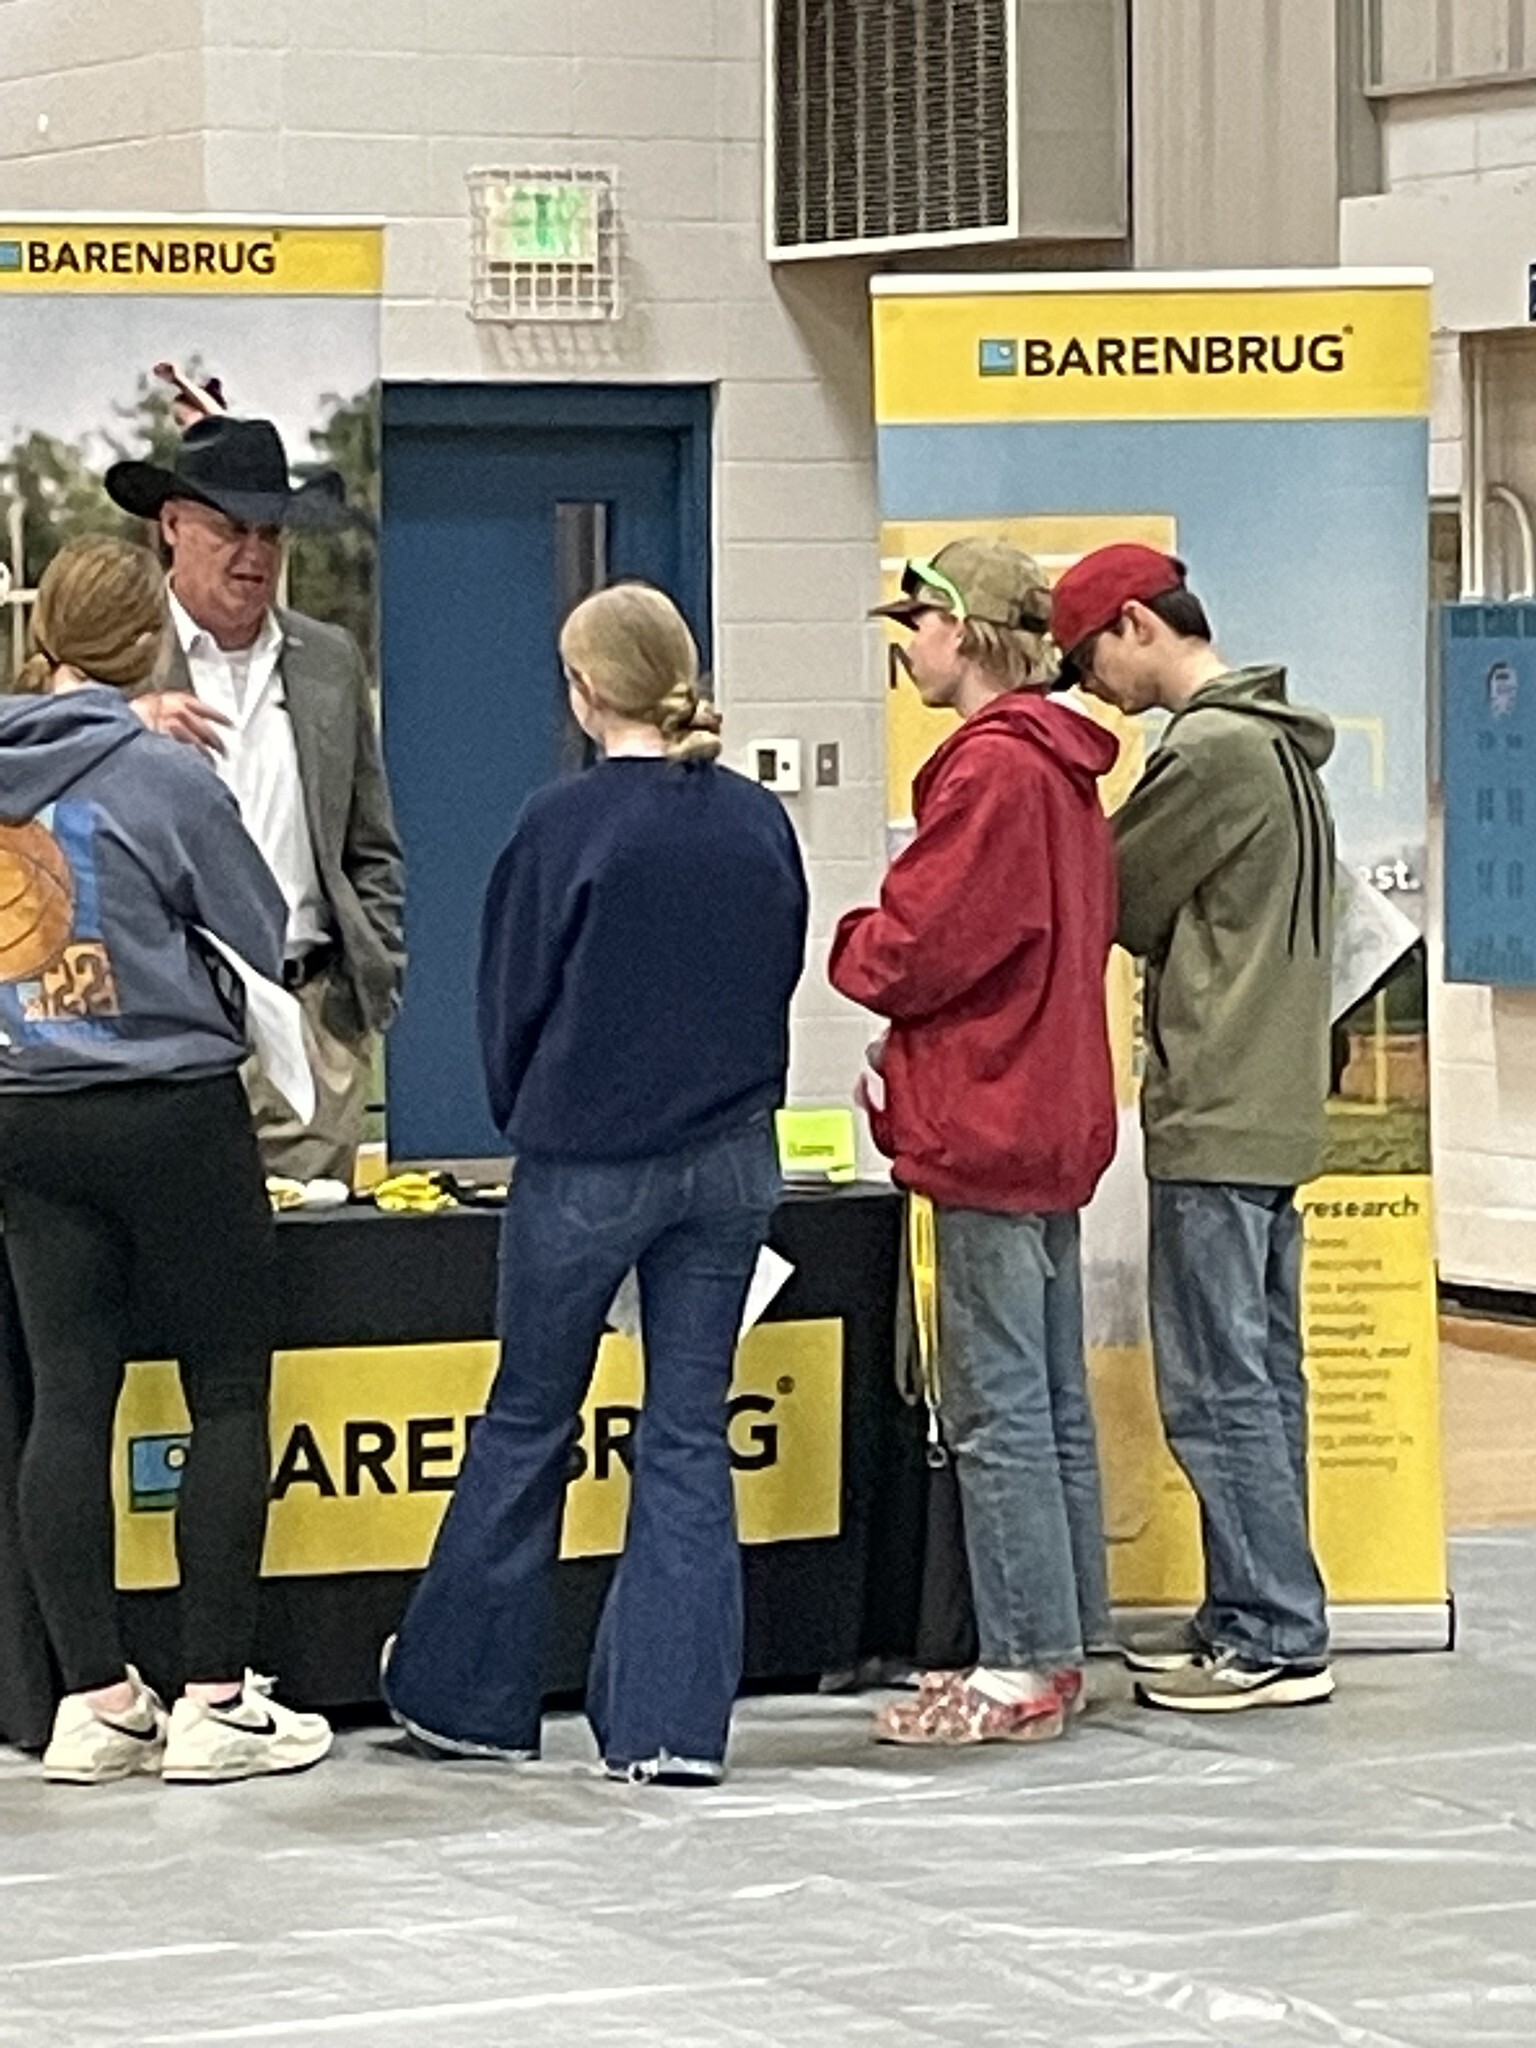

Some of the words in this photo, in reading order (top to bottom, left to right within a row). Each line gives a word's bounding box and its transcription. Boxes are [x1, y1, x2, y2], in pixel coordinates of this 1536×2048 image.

[28, 241, 276, 274] BARENBRUG
[1024, 334, 1344, 376] BARENBRUG
[1303, 1194, 1420, 1218] research
